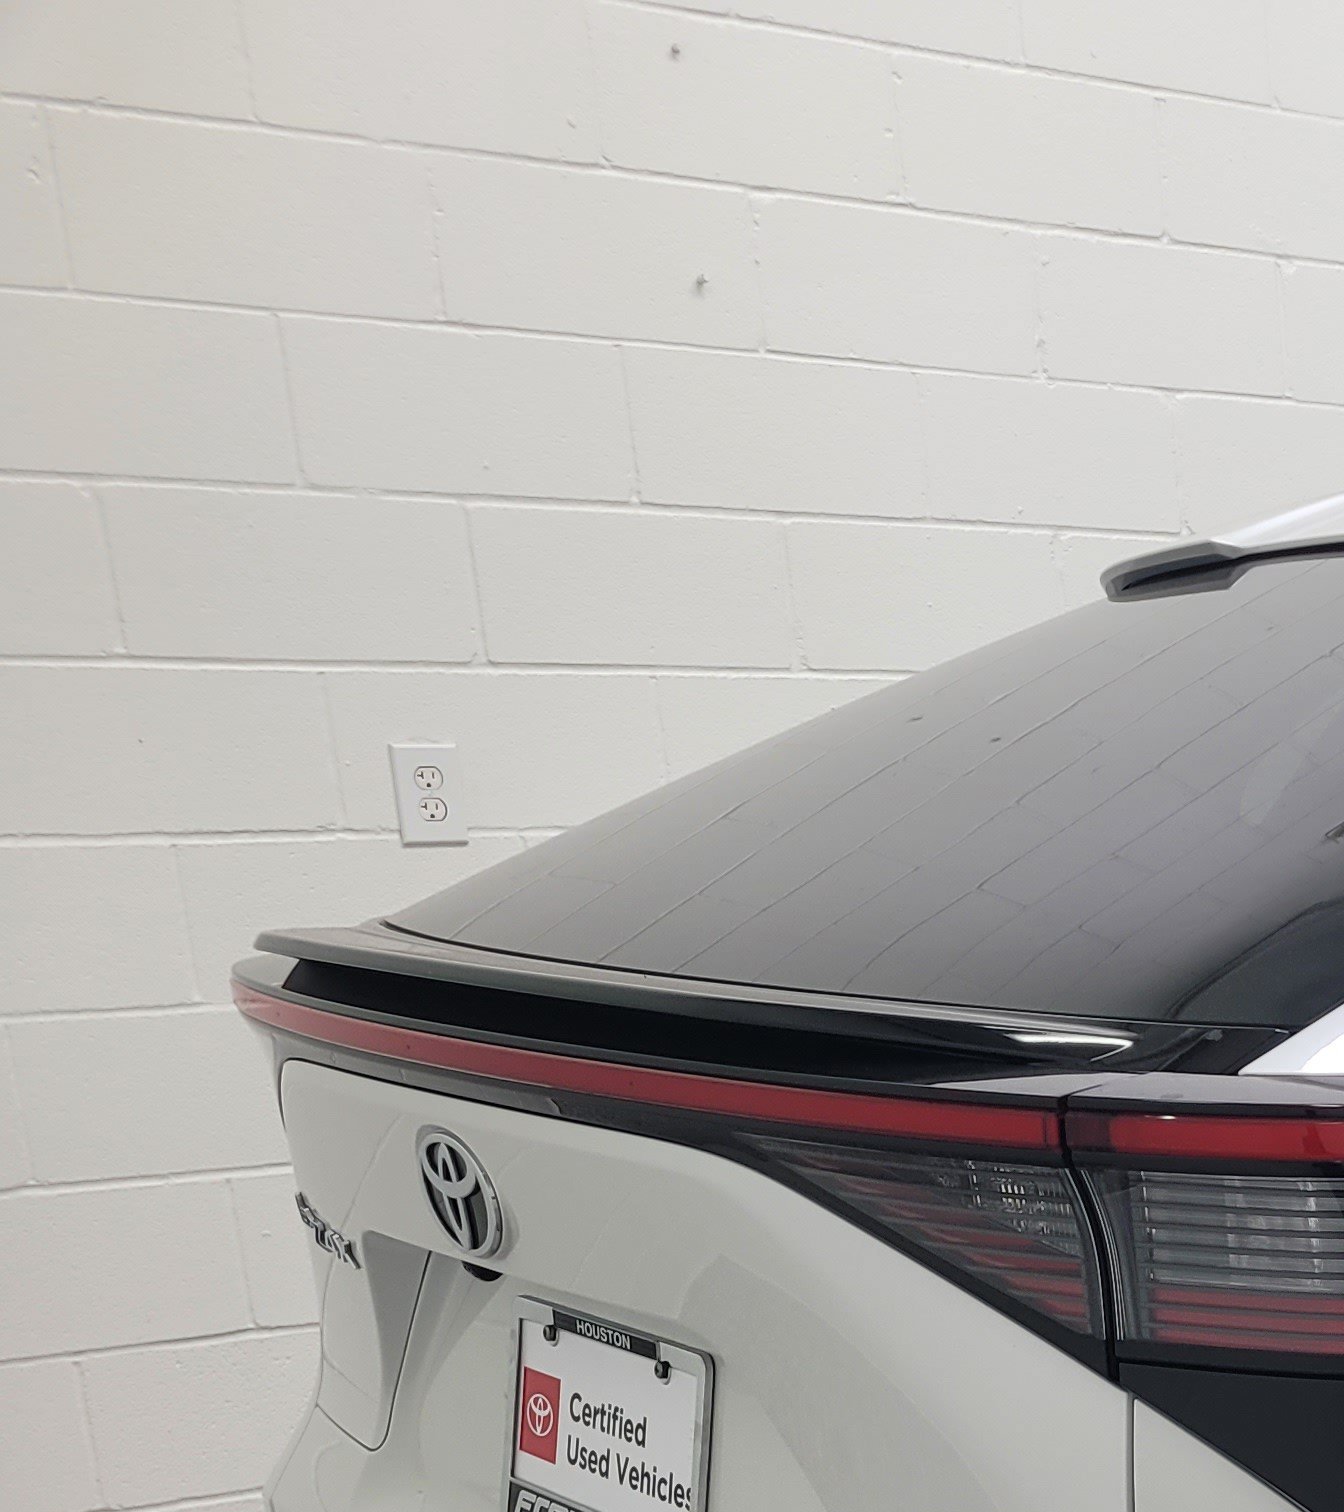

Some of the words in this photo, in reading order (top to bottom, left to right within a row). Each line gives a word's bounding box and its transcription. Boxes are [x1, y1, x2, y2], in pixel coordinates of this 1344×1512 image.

[575, 1319, 631, 1350] HOUSTON
[569, 1392, 647, 1448] Certified
[566, 1434, 611, 1480] Used
